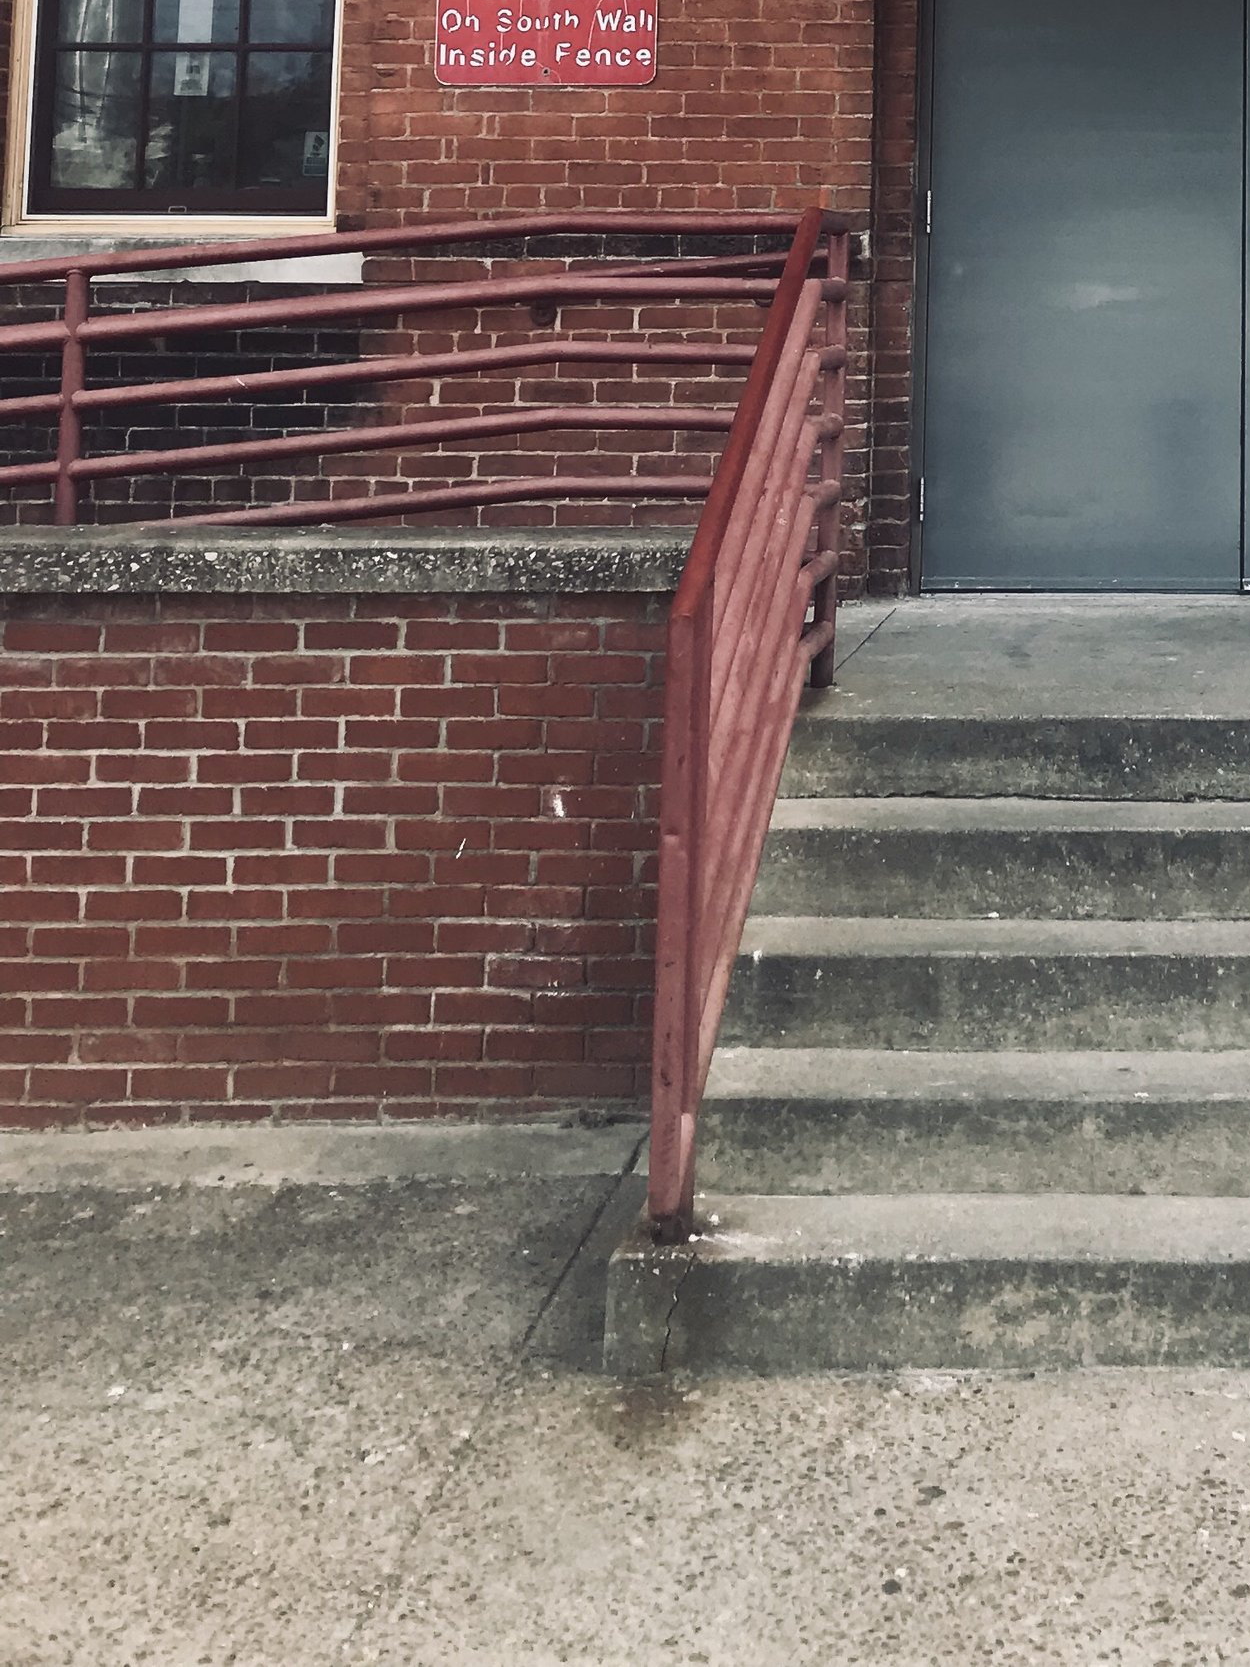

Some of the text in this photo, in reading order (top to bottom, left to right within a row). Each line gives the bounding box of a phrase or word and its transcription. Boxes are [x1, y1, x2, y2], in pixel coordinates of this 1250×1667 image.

[441, 8, 653, 33] On South Wall
[439, 42, 652, 67] Inside Fence
